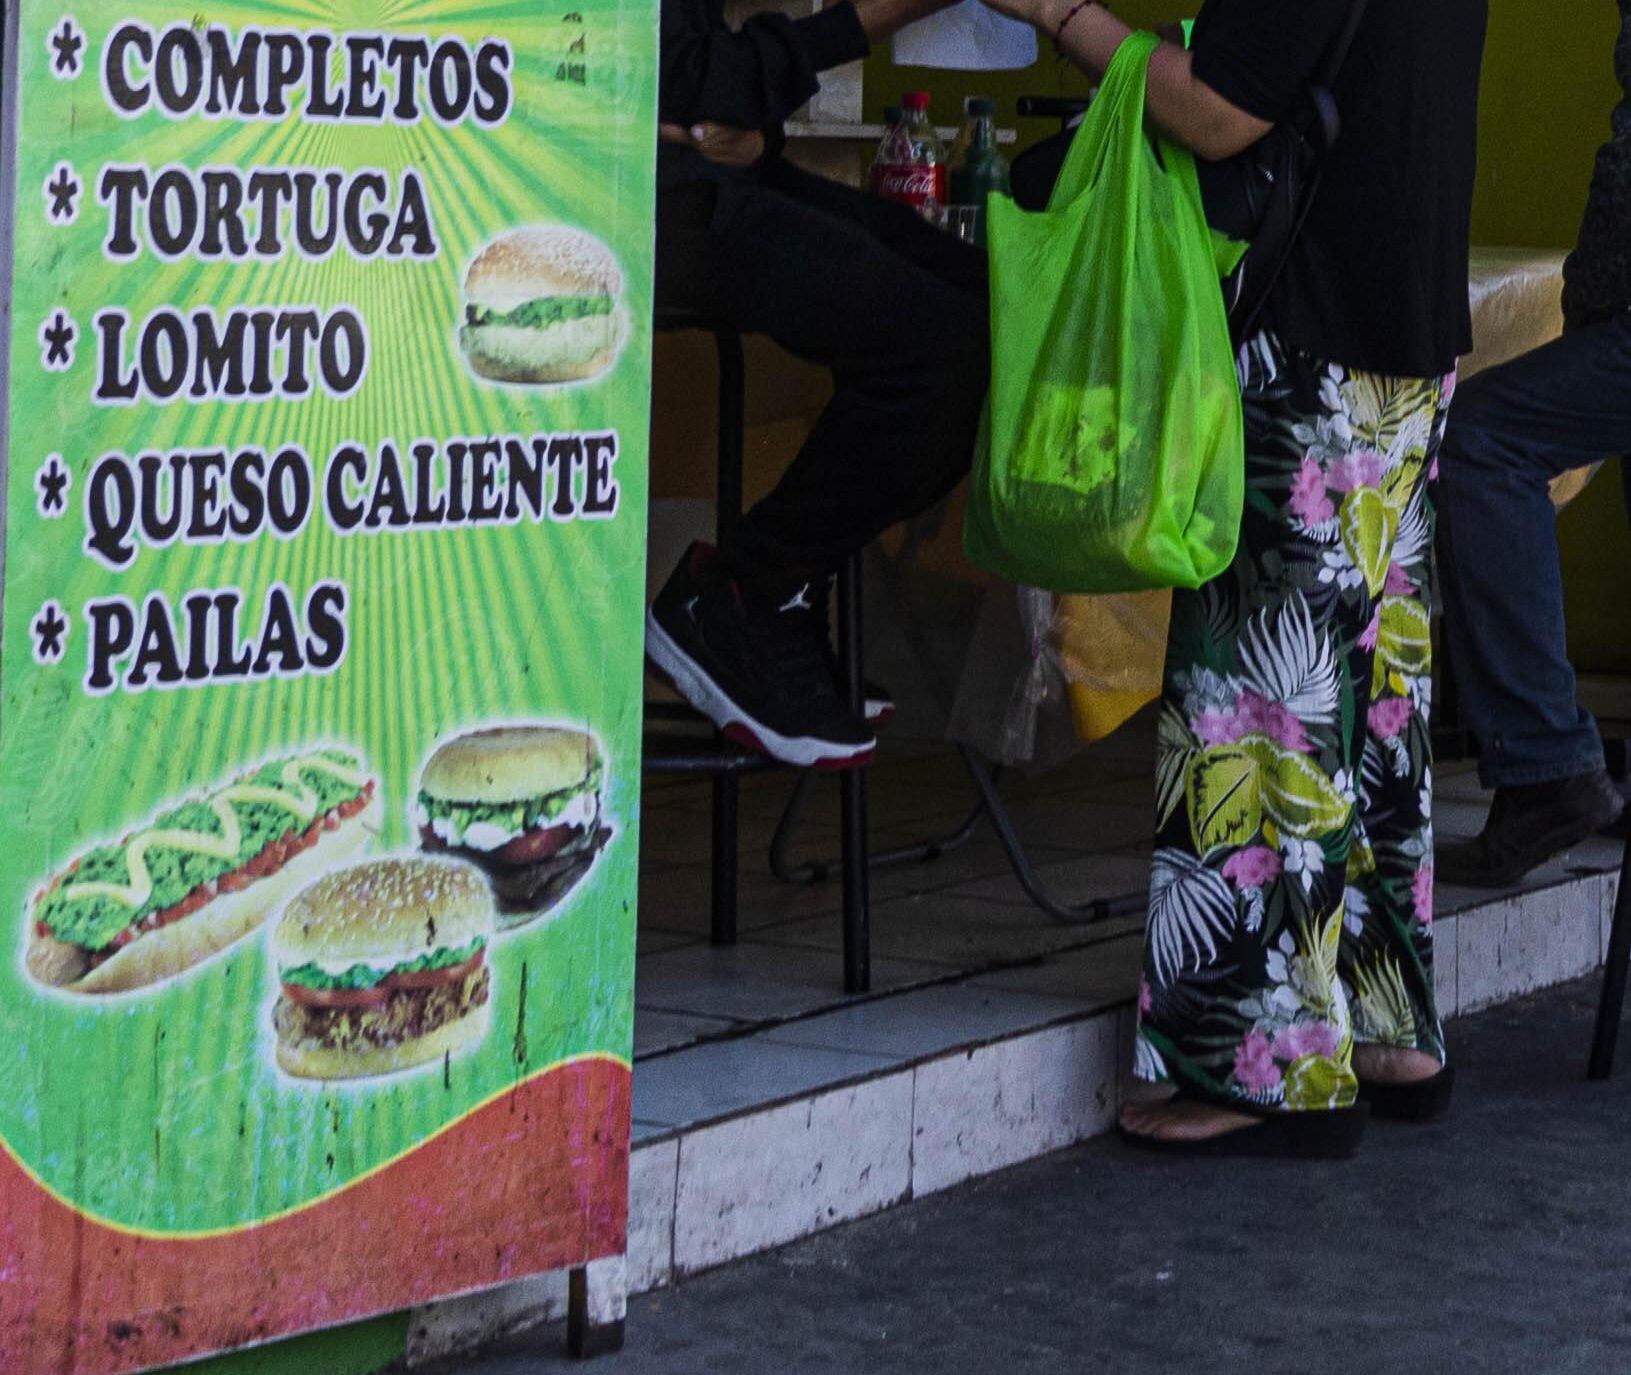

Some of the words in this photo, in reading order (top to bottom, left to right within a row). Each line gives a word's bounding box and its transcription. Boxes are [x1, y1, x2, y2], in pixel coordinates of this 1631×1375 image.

[106, 25, 511, 122] COMPLETOS
[100, 169, 437, 256] TORTUGA
[96, 310, 365, 400] LOMITO
[88, 448, 310, 564] QUESO
[326, 435, 618, 531] CALIENTE
[86, 584, 345, 689] PAILAS
